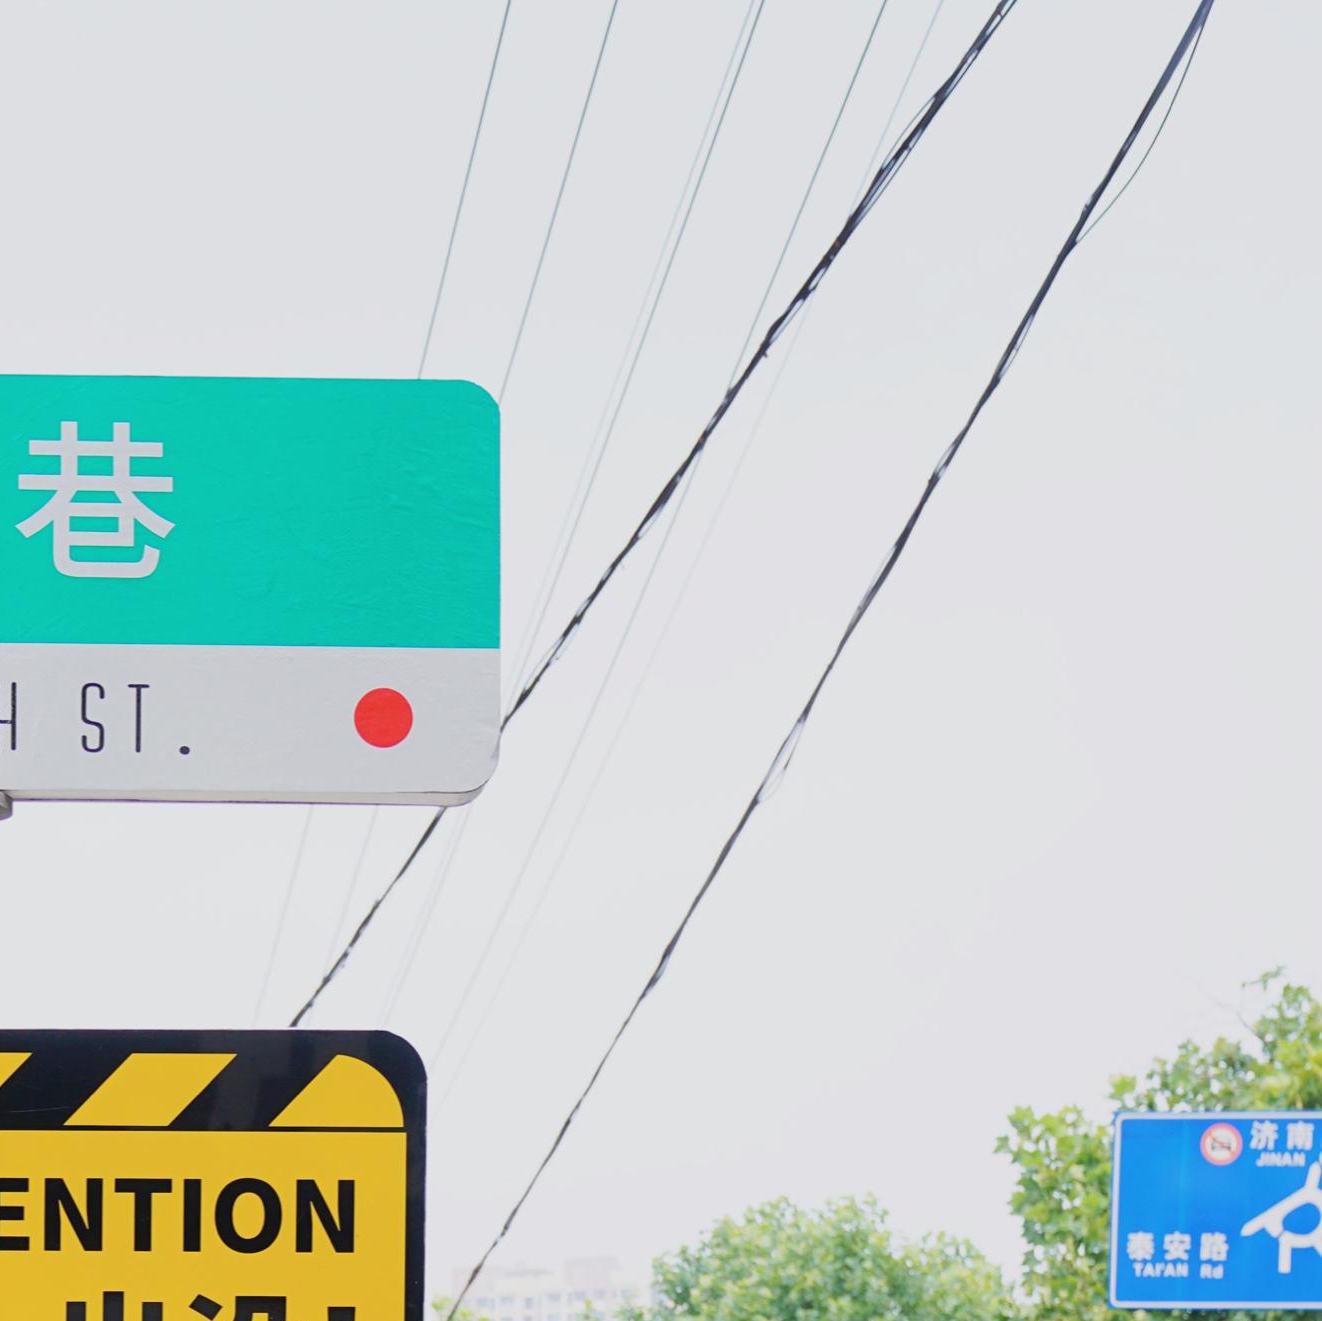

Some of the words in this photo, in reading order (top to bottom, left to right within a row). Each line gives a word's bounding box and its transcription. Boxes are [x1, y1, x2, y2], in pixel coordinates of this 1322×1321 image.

[80, 682, 191, 756] ST.
[1250, 1120, 1315, 1151] 济南
[1256, 1152, 1306, 1167] JINAN
[1126, 1231, 1229, 1262] 泰安路
[1199, 1264, 1224, 1280] Rd
